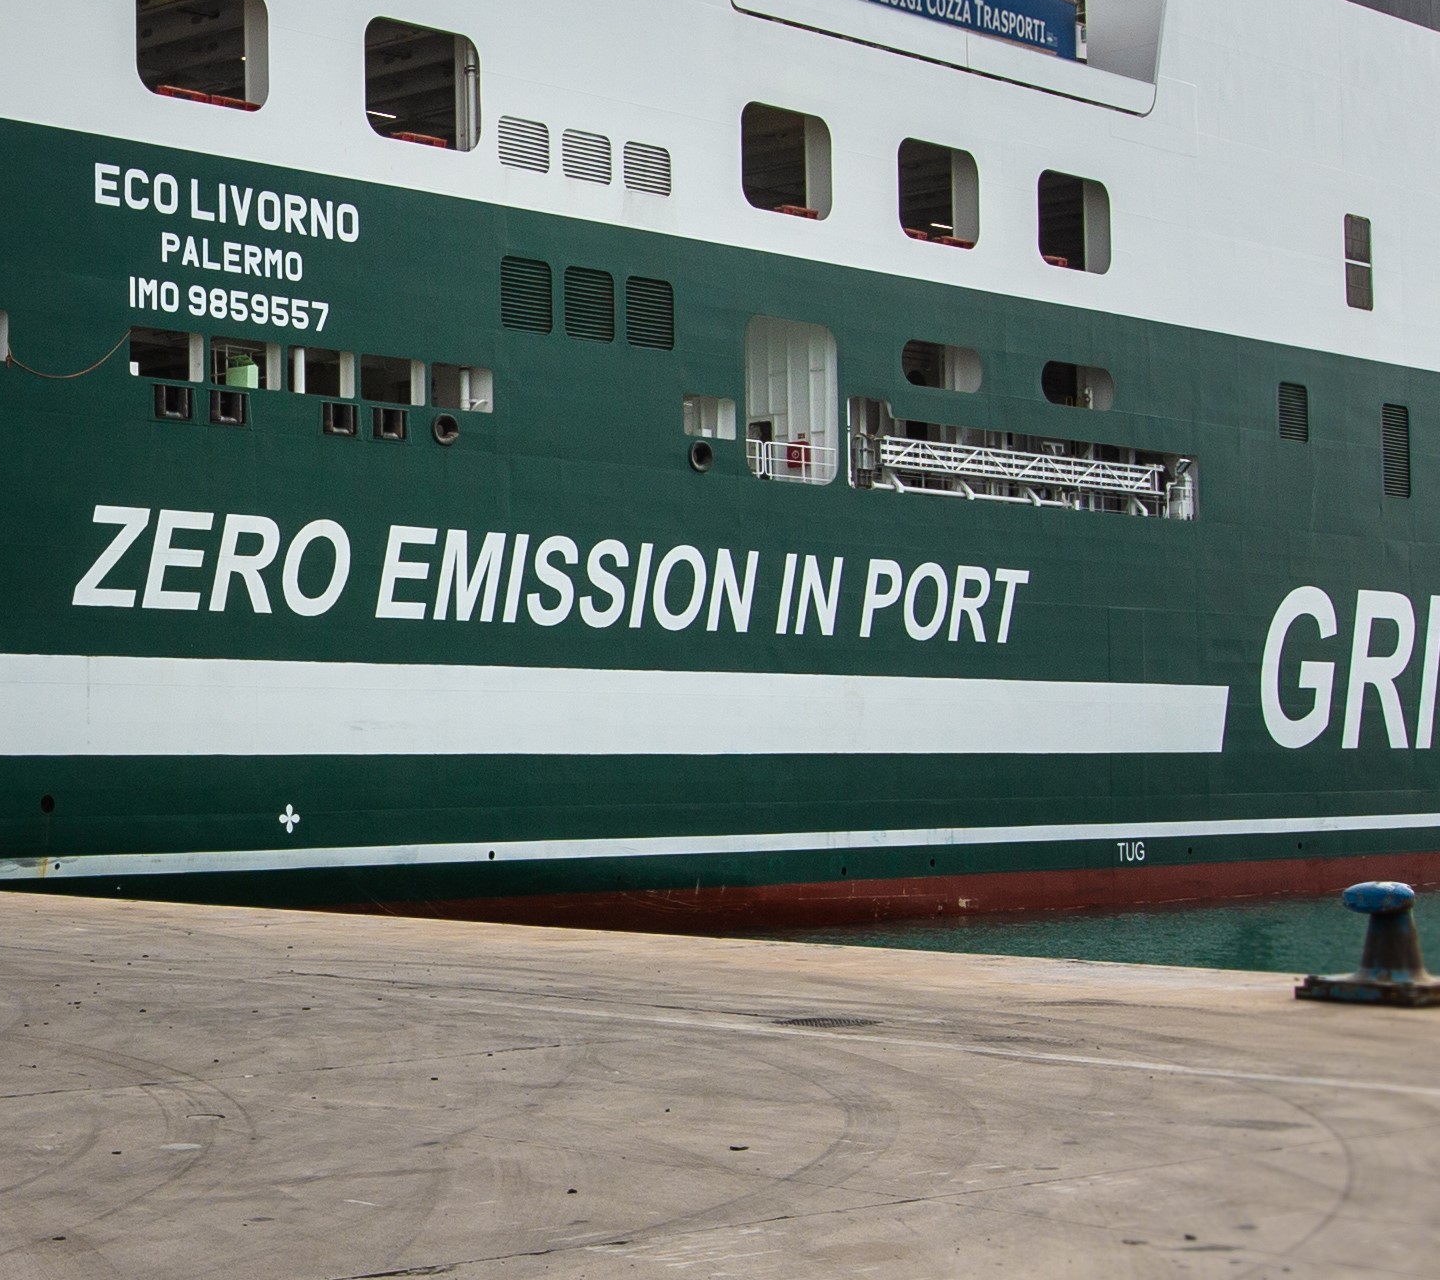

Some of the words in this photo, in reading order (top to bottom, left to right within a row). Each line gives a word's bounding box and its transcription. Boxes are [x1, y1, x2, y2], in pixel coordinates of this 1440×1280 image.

[94, 162, 179, 214] ECO
[191, 181, 360, 243] LIVORNO
[161, 231, 303, 282] PALERMO
[129, 276, 180, 313] IMO
[188, 280, 330, 332] 9859557
[72, 505, 351, 617] ZERO
[375, 525, 759, 633] EMISSION
[775, 553, 844, 637] IN
[859, 558, 1030, 644] PORT
[1116, 841, 1145, 862] TUG
